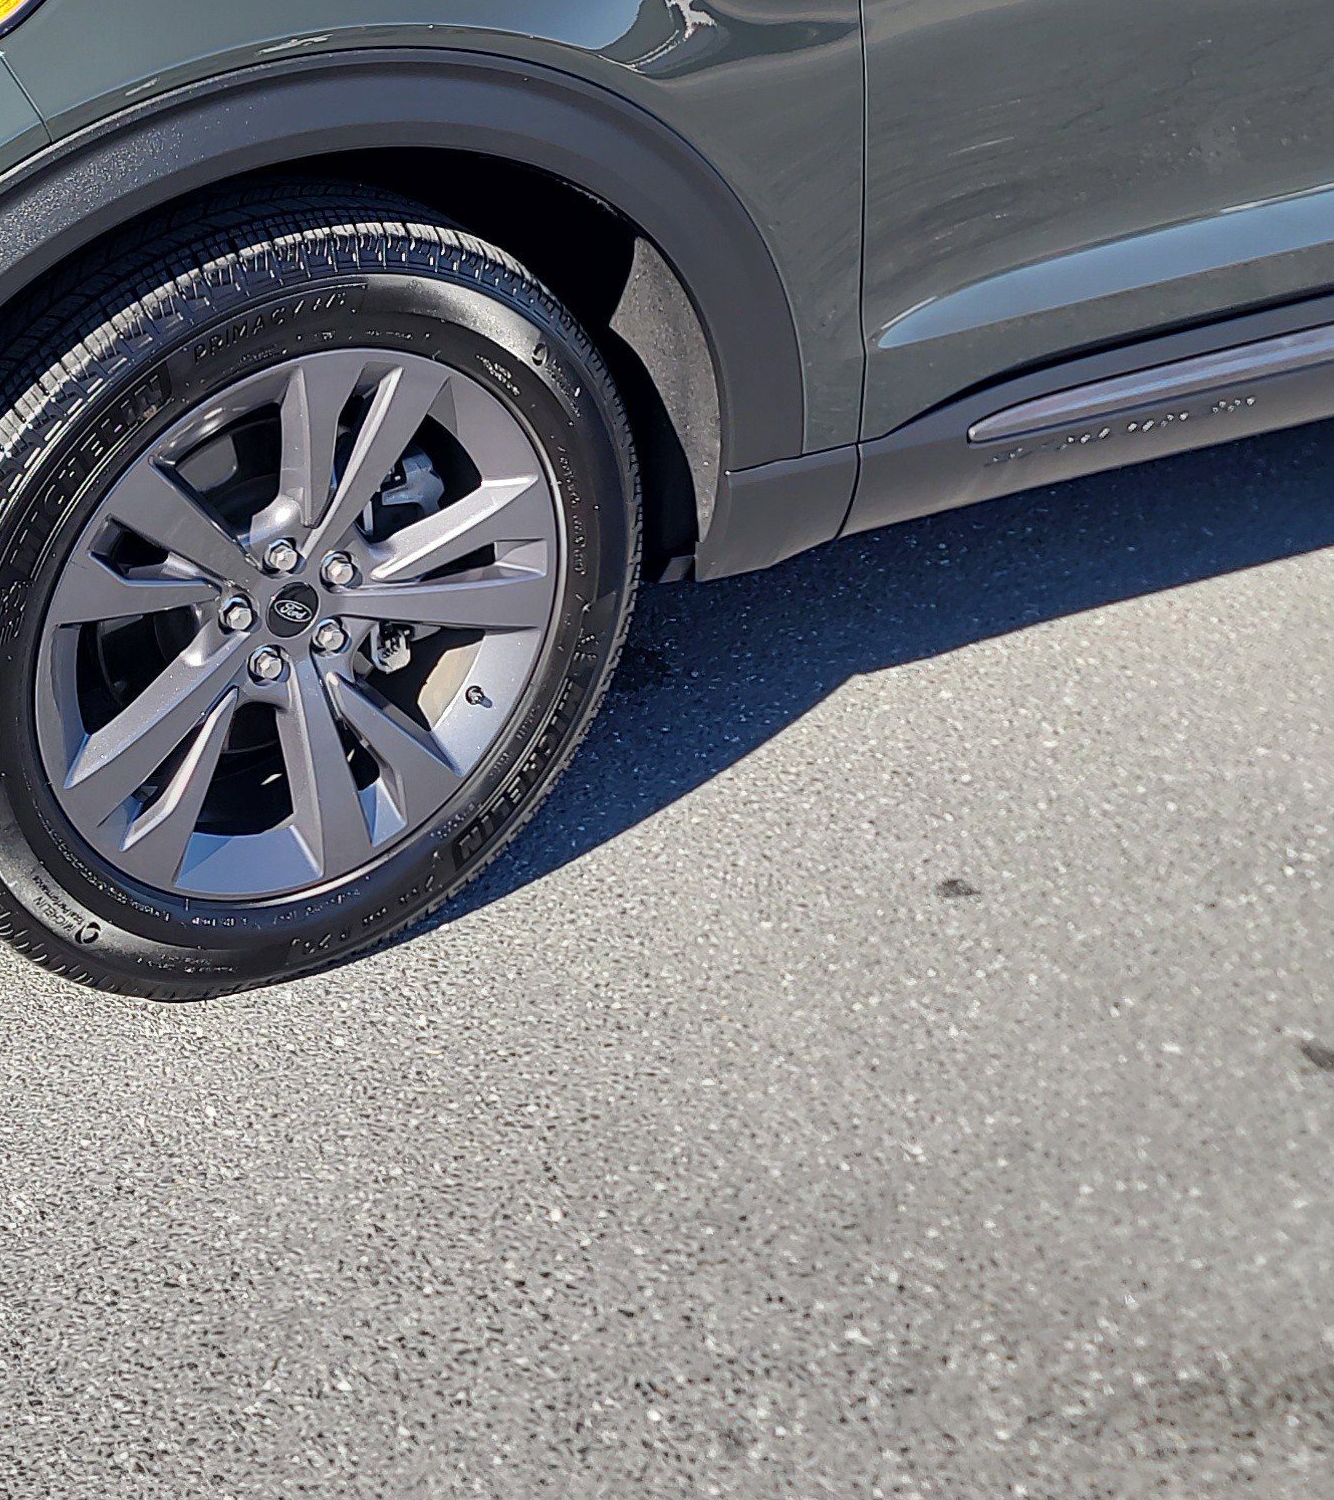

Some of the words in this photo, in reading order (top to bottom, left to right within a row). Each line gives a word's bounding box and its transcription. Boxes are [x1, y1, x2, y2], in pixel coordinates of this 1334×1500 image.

[9, 372, 166, 579] MICHELIN
[280, 602, 307, 619] Ford
[458, 677, 585, 861] MICHELIN
[33, 896, 78, 933] MICHELIN
